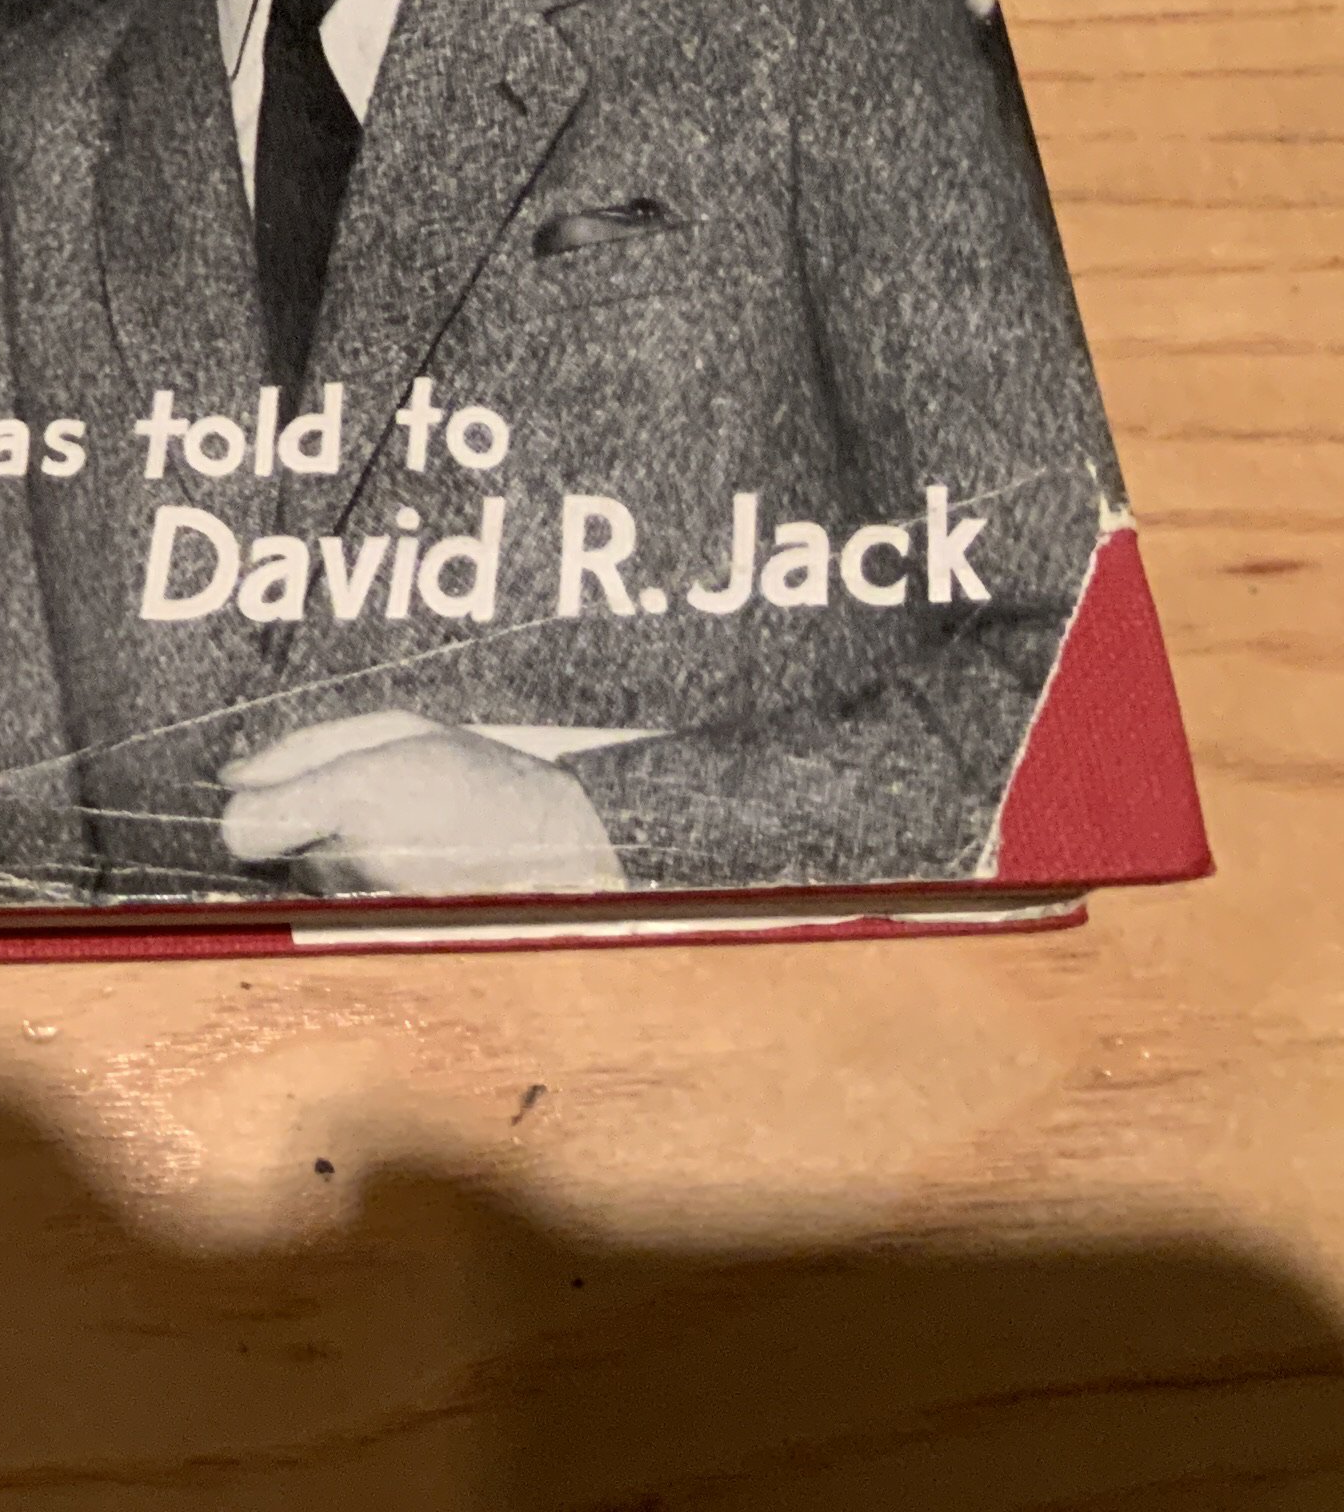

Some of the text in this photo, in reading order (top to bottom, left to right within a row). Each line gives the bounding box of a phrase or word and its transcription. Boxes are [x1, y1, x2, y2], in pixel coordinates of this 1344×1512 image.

[134, 382, 343, 480] told
[394, 376, 509, 472] to
[138, 494, 506, 623] David
[687, 485, 991, 614] Jack
